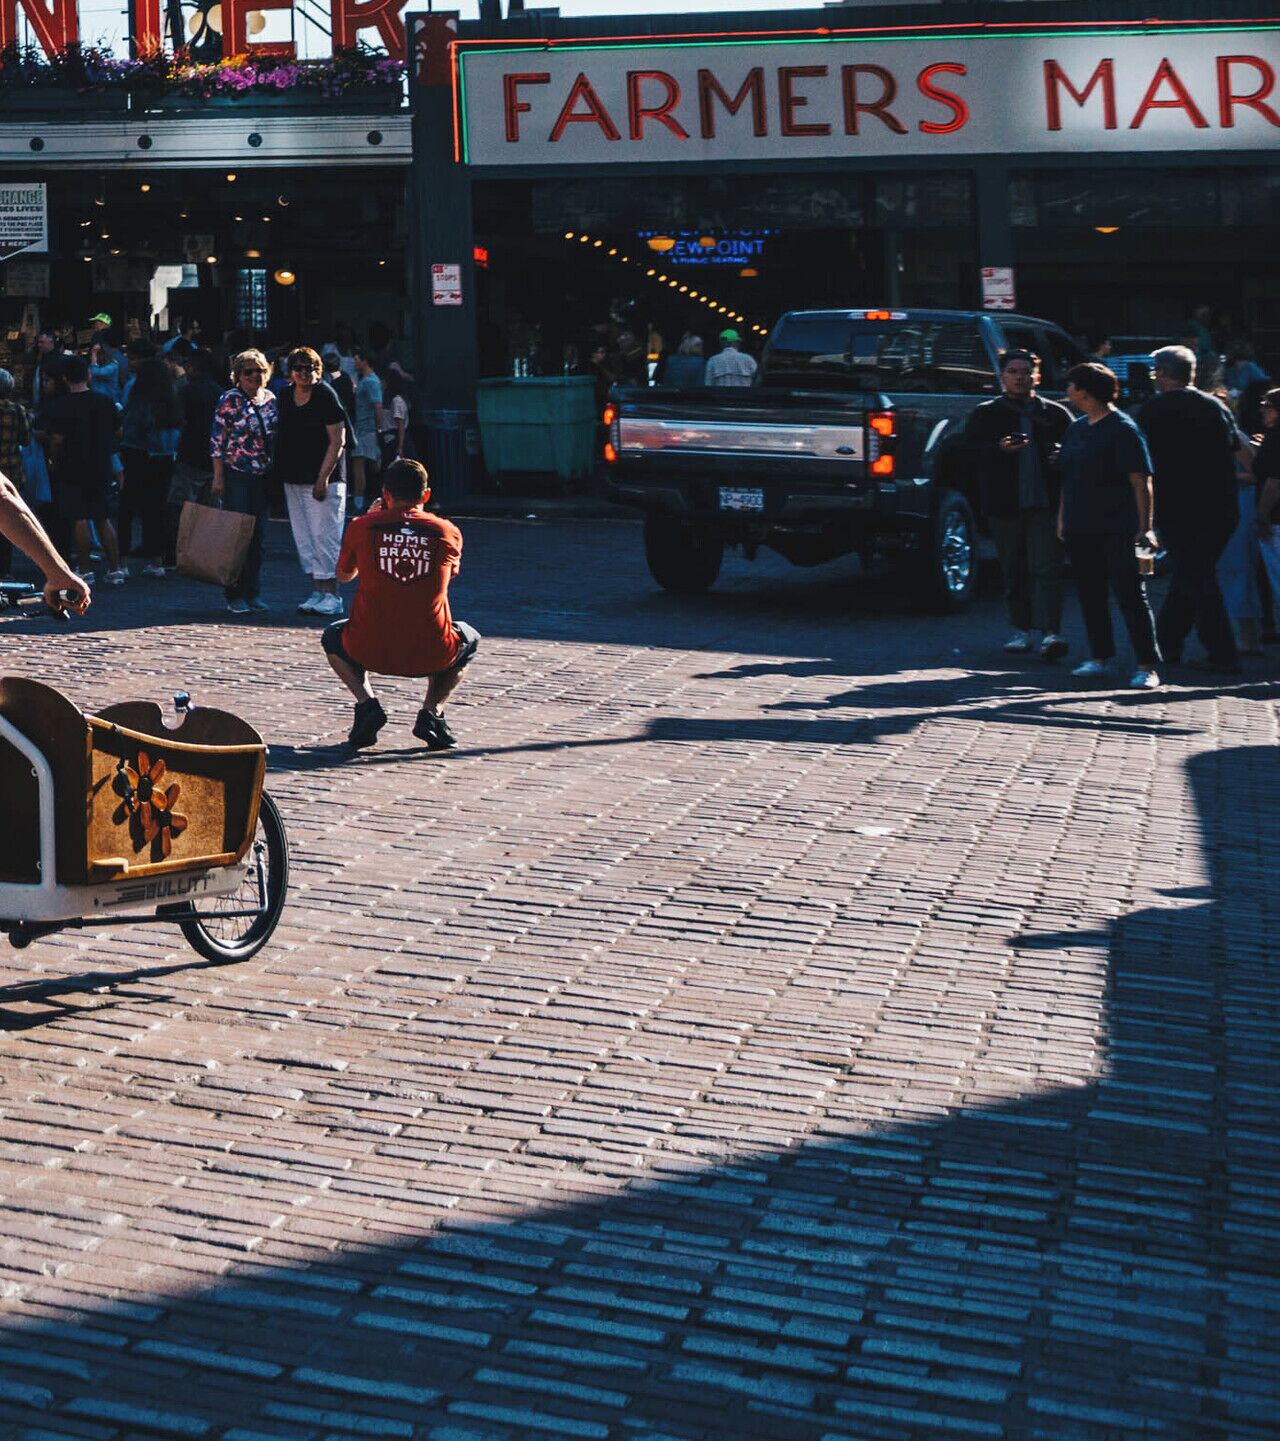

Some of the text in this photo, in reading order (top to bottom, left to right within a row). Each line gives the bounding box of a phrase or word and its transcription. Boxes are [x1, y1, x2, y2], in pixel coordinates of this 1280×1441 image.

[503, 54, 1280, 143] FARMERS MAR
[383, 533, 428, 545] HOME
[380, 547, 431, 560] BRAVE
